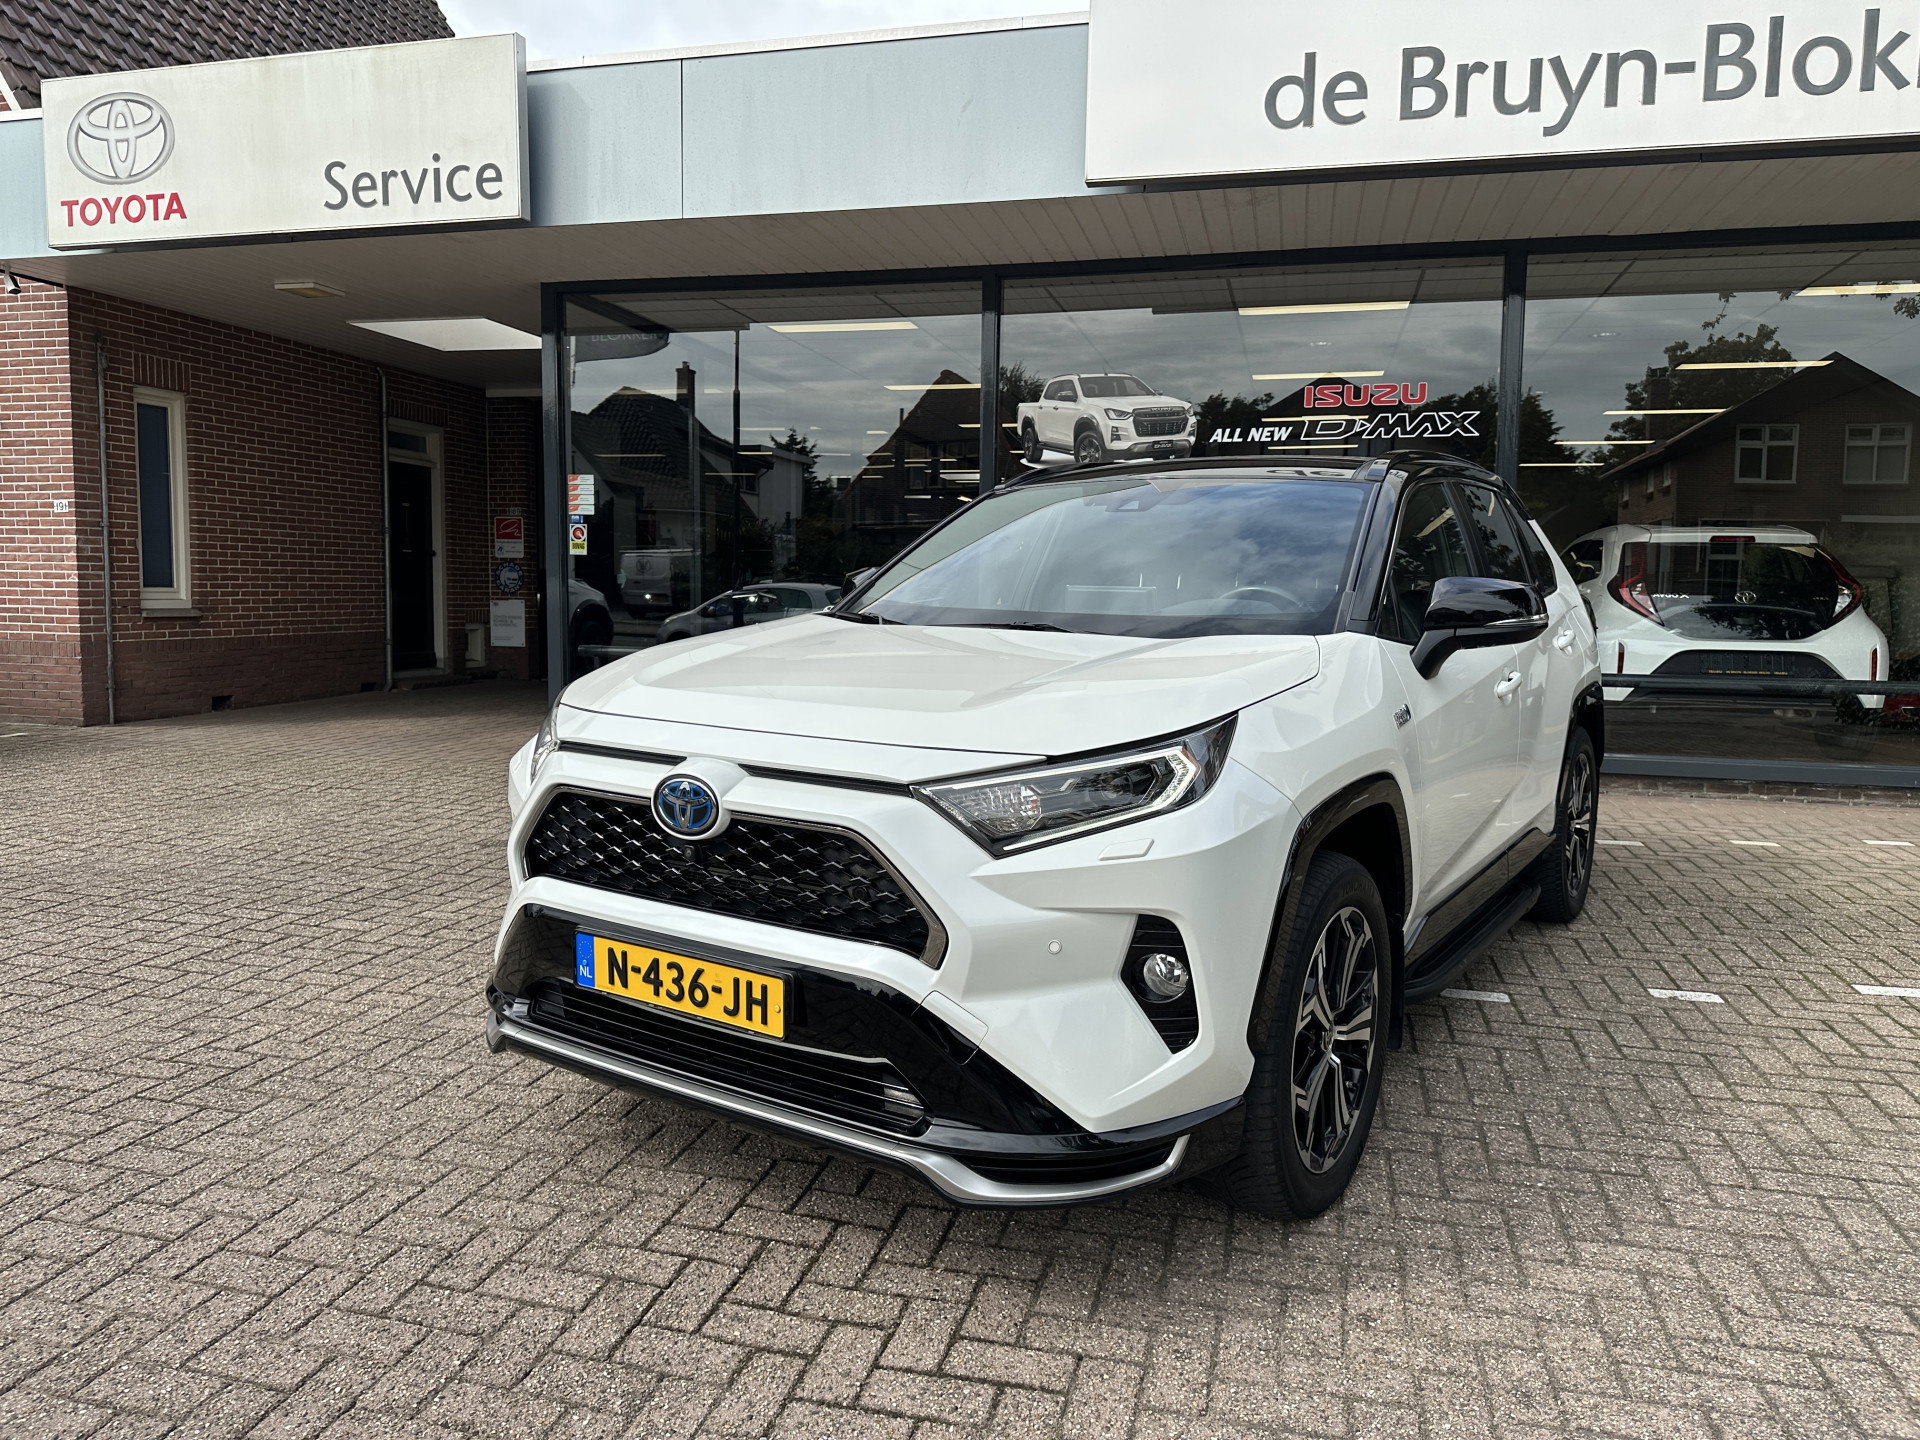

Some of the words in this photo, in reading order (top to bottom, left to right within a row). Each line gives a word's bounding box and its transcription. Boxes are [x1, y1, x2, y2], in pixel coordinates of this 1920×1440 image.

[1264, 51, 1368, 130] de
[1399, 8, 1920, 138] Bruyn-Blok
[323, 153, 504, 211] Service
[60, 191, 188, 228] TOYOTA
[1303, 382, 1428, 408] ISUZU
[1209, 427, 1243, 443] ALL
[1247, 426, 1294, 442] NEW
[56, 501, 68, 511] 191
[579, 964, 592, 979] NL
[607, 946, 768, 1026] N-436-JH
